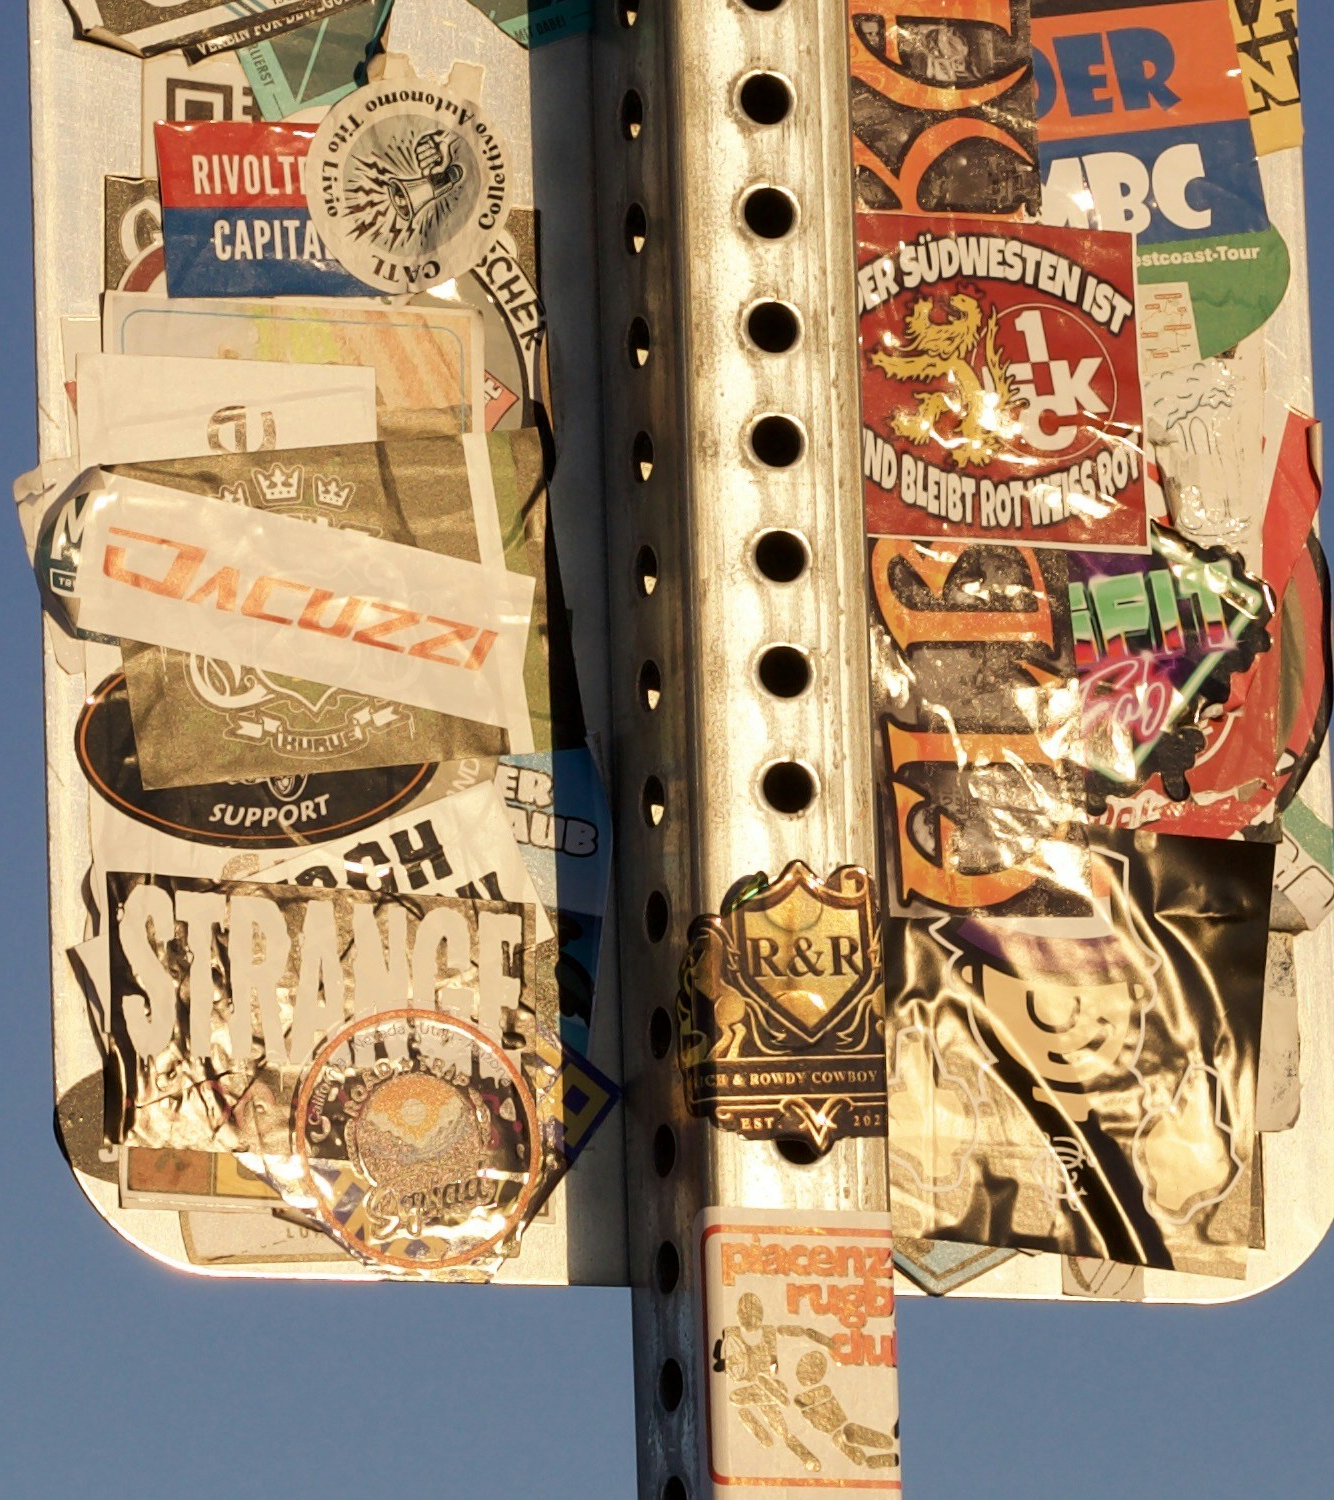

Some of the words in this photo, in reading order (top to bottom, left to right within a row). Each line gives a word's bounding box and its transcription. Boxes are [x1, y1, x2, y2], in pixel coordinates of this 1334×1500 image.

[364, 89, 476, 126] Autonomo
[327, 113, 365, 154] Tito
[321, 159, 340, 219] Livio
[213, 218, 335, 262] CAPITA
[370, 254, 442, 285] CATL
[898, 233, 1083, 303] SÜDWESTEN
[1082, 275, 1134, 335] IST
[863, 429, 899, 490] ND
[900, 453, 976, 525] BLEIBT
[979, 478, 1025, 529] ROT
[1096, 437, 1140, 497] ROT
[102, 525, 500, 672] JACUZZI
[208, 793, 330, 828] SUPPORT
[747, 935, 865, 979] R&R
[732, 1072, 746, 1087] &
[749, 1070, 806, 1086] ROWDY
[811, 1069, 878, 1085] COWBOY
[852, 1113, 887, 1128] 202
[720, 1233, 895, 1287] piacenz
[786, 1276, 896, 1329] rugb
[830, 1328, 898, 1368] clu
